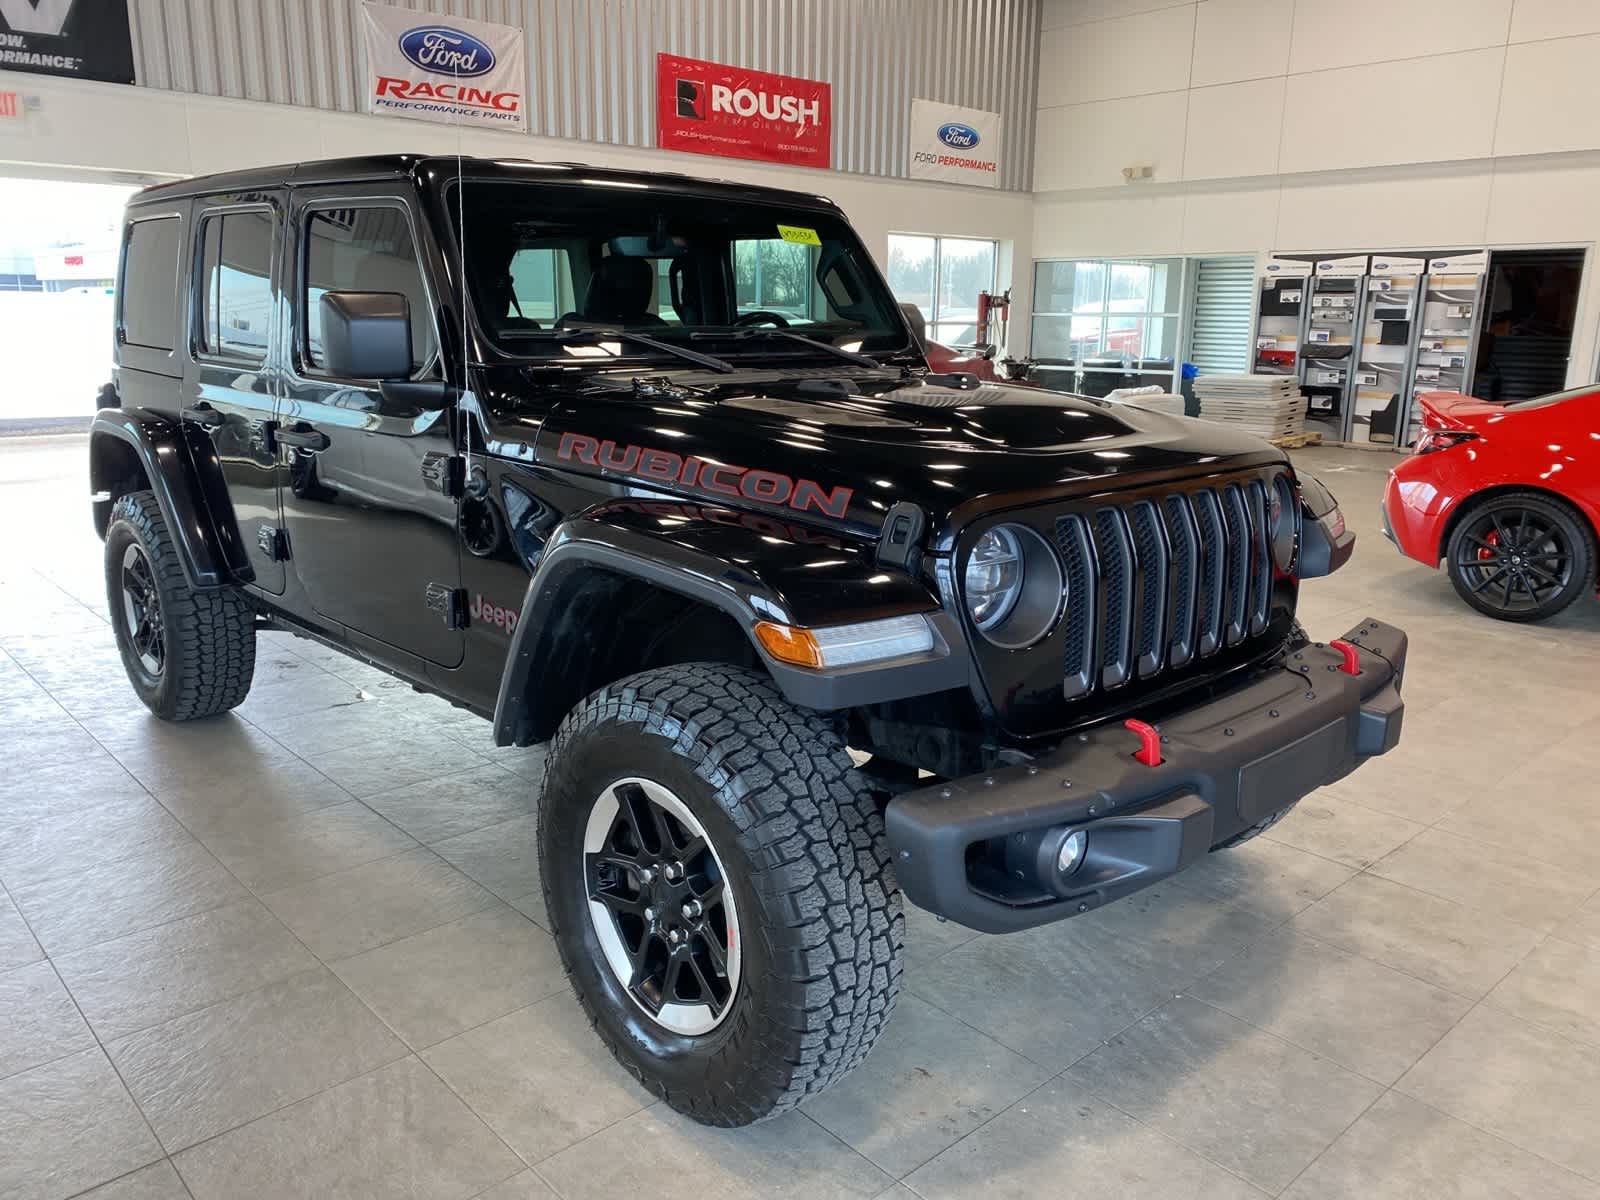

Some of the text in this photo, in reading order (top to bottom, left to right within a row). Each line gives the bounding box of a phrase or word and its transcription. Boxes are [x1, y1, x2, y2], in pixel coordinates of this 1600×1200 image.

[418, 32, 478, 71] Ford
[375, 75, 520, 112] RACING
[376, 98, 521, 122] PERFORMANCE PARTS
[711, 83, 820, 127] ROUSH
[945, 126, 972, 146] Ford
[914, 151, 997, 173] FORD PERFORMANCE
[556, 431, 855, 519] RUBICON
[470, 592, 518, 635] Jeep
